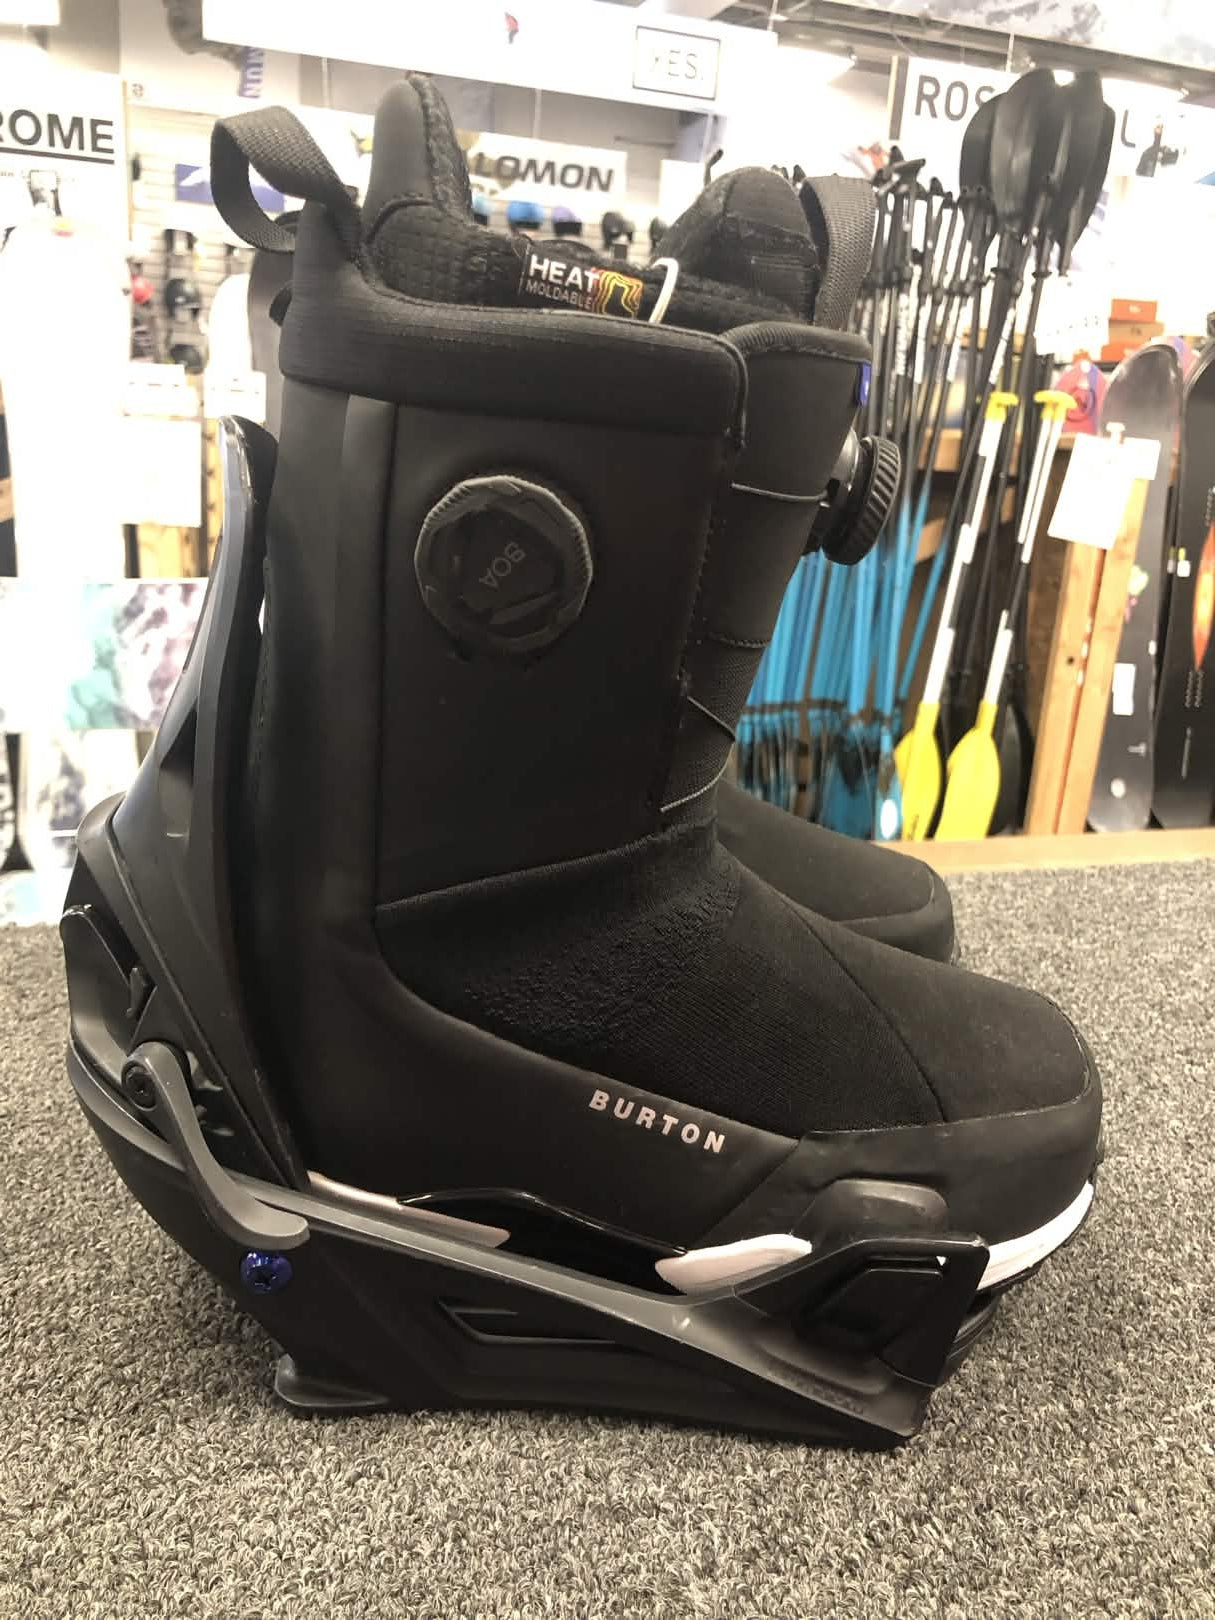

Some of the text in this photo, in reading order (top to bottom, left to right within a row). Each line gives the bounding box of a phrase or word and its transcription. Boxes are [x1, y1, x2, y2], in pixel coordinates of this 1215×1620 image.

[0, 109, 115, 154] OME
[474, 152, 614, 192] LOMON
[525, 279, 593, 310] MOLDABLE
[529, 254, 600, 293] HEAT
[478, 541, 527, 589] BOA
[588, 1089, 726, 1154] BURTON
